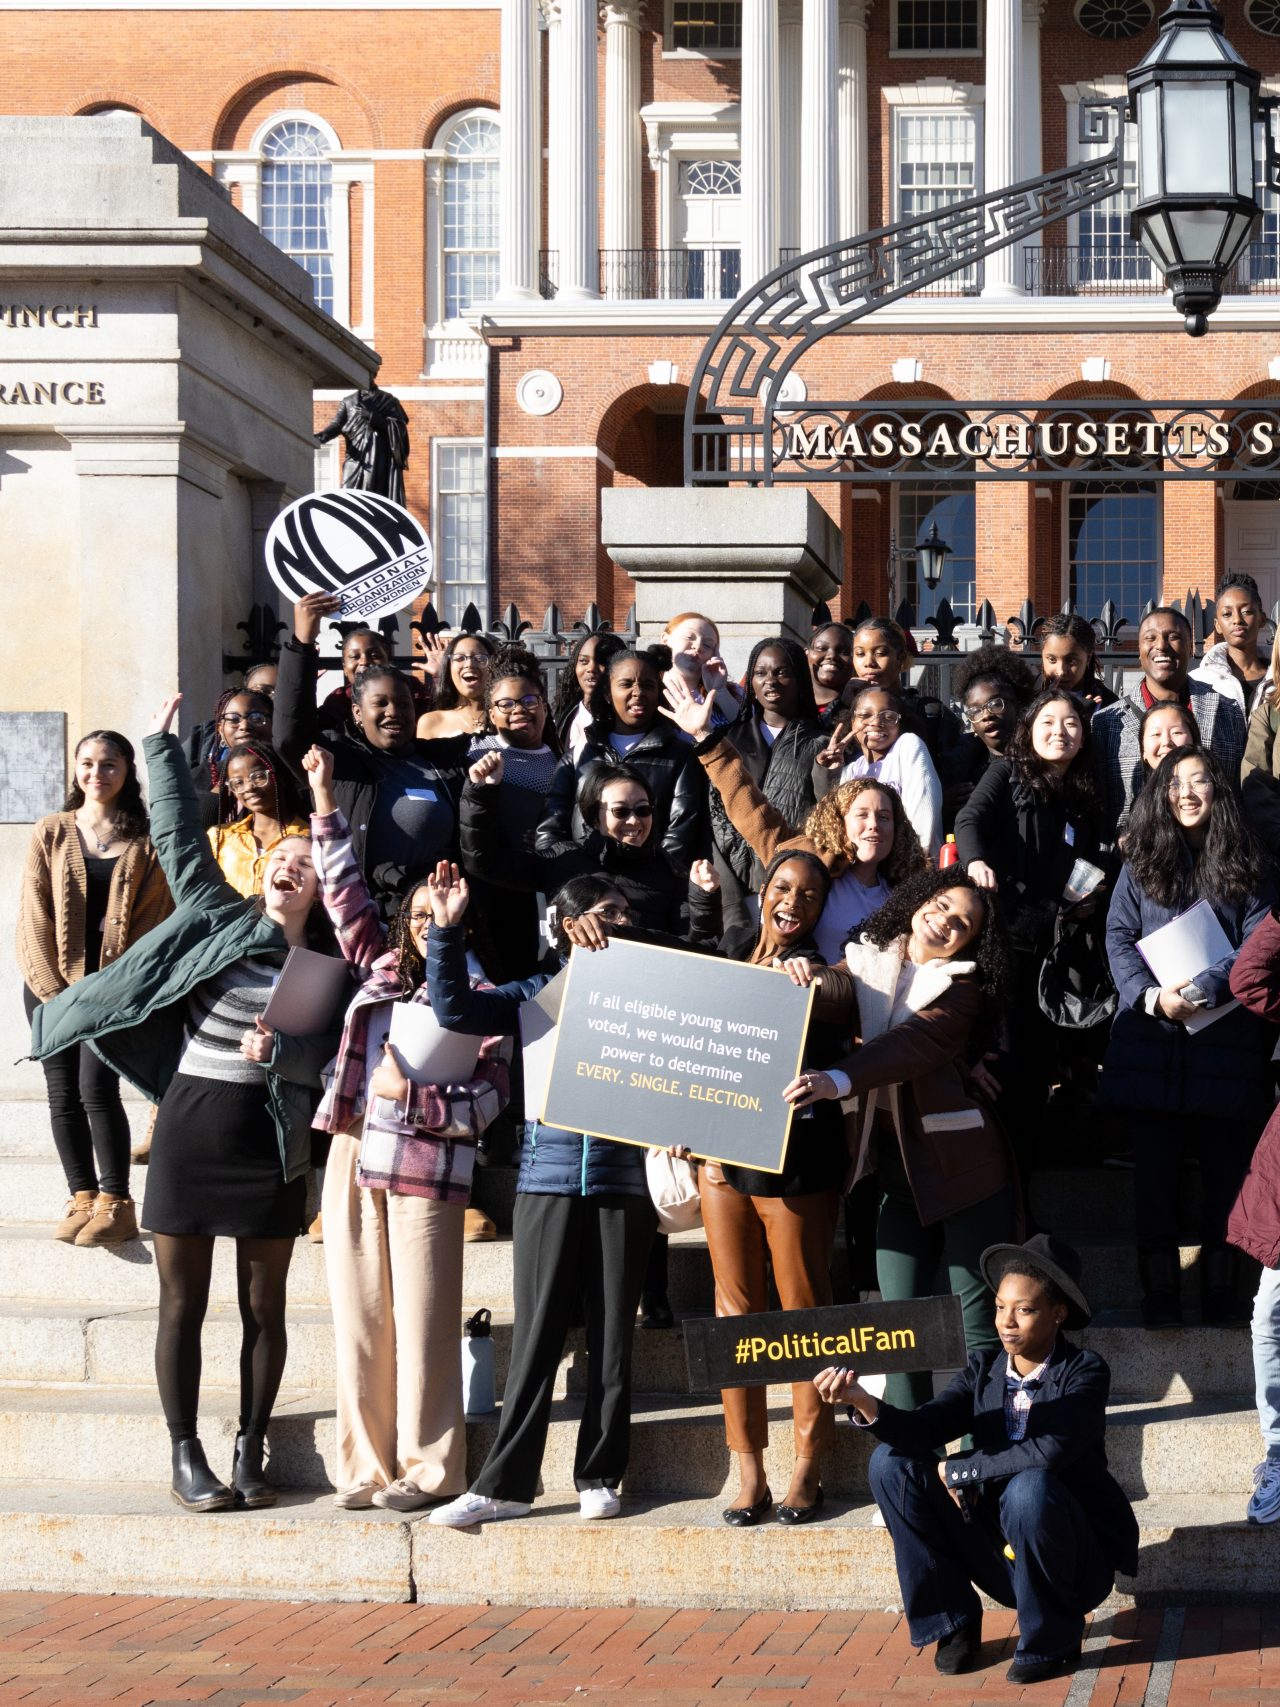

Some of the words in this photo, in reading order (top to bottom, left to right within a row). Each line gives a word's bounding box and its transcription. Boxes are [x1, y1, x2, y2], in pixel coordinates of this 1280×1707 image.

[0, 304, 100, 328] INCH
[788, 422, 1231, 458] MASSACHUSETTS
[273, 492, 425, 598] NOW
[340, 553, 428, 602] ATIONAL
[340, 566, 426, 615] ORGANIZATION
[359, 601, 380, 616] FOR
[380, 580, 420, 602] WOMEN
[588, 991, 600, 1005] If
[602, 995, 621, 1010] all
[624, 1000, 677, 1020] eligible
[679, 1012, 723, 1033] young
[727, 1019, 779, 1041] women
[587, 1017, 631, 1039] voted,
[636, 1026, 657, 1041] we
[661, 1031, 704, 1051] would
[707, 1038, 742, 1058] have
[746, 1047, 771, 1063] the
[576, 1062, 624, 1084] EVERY.
[629, 1072, 683, 1096] SINGLE.
[689, 1084, 763, 1112] ELECTION.
[600, 1045, 646, 1063] power
[649, 1053, 664, 1067] to
[668, 1056, 743, 1083] determine
[735, 1326, 916, 1364] #PoliticalFam
